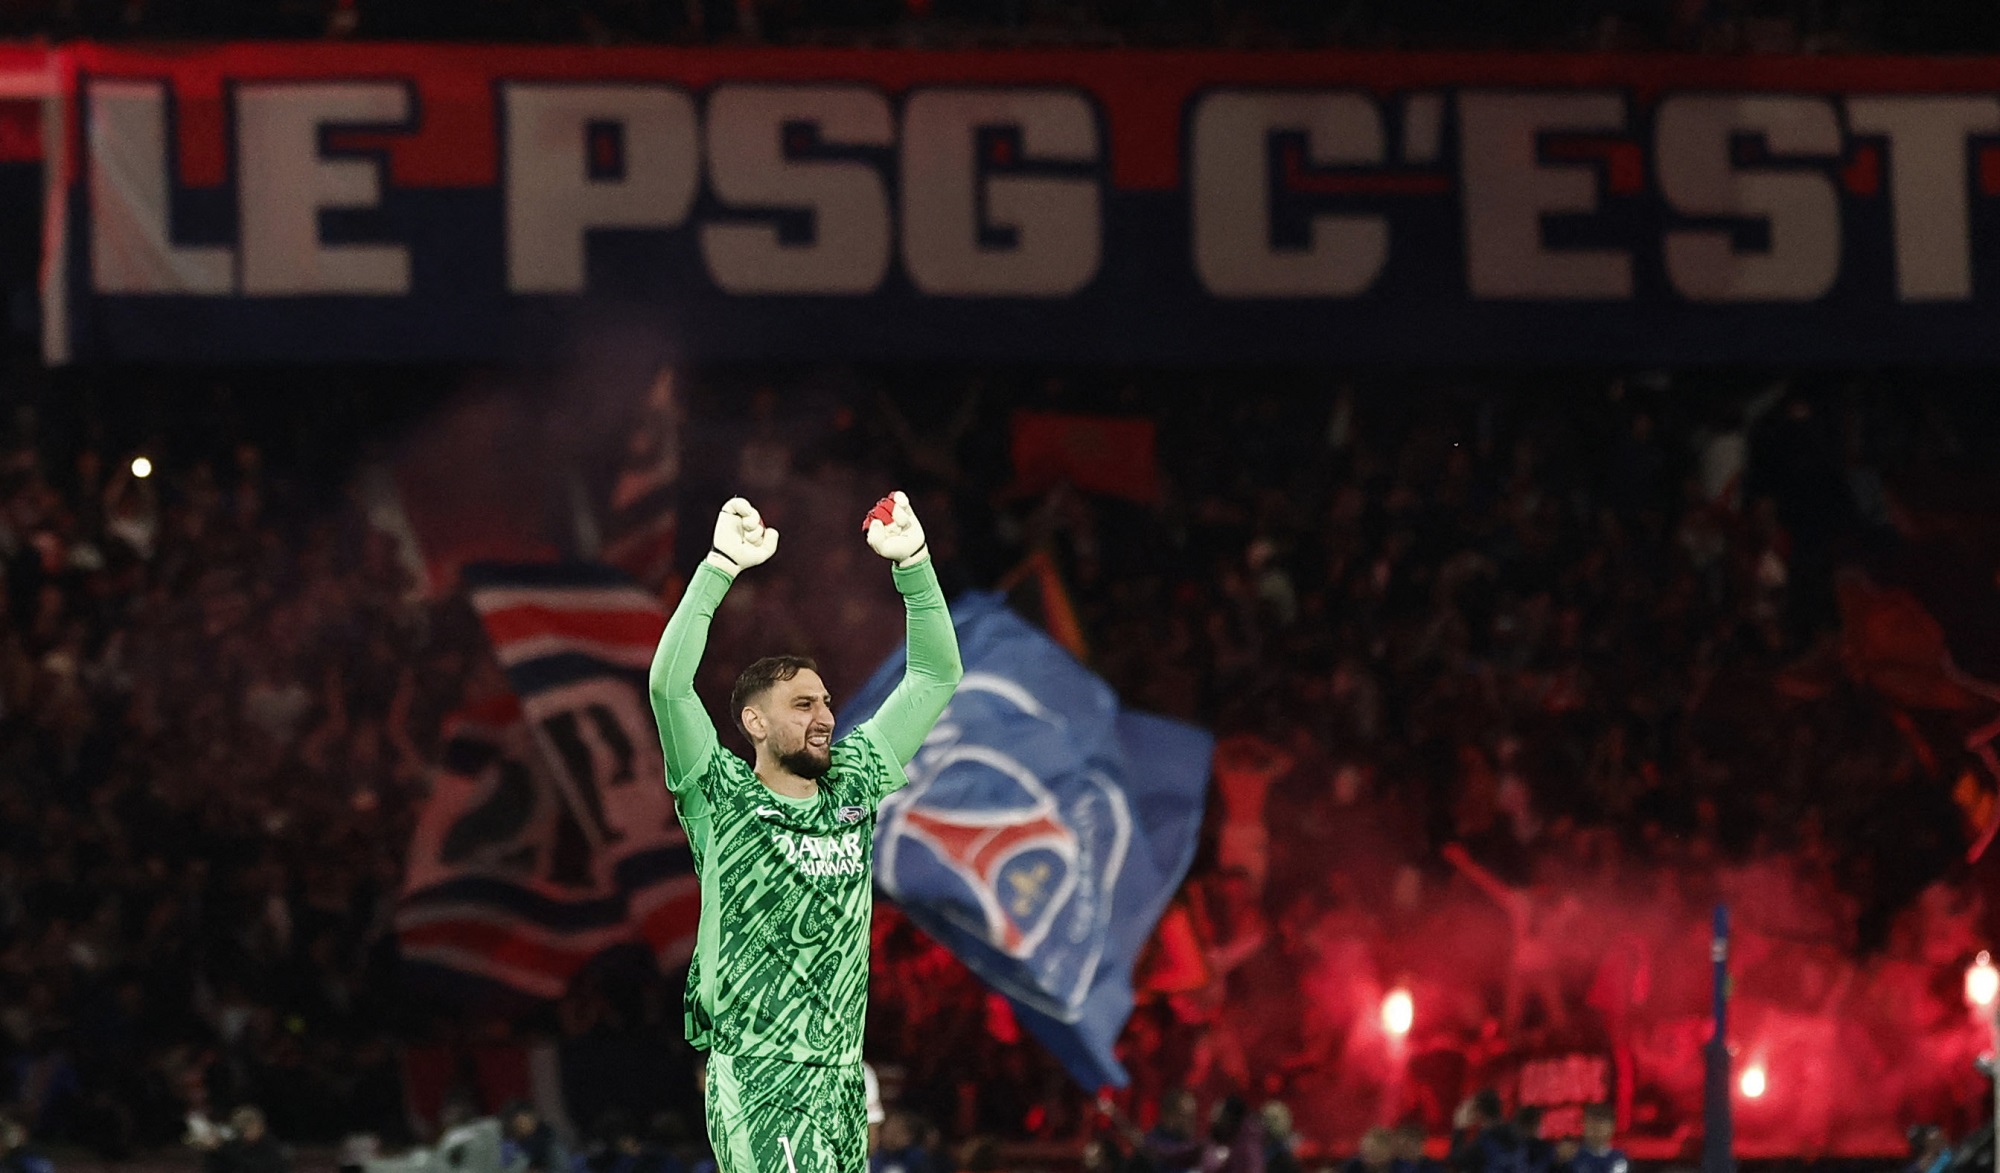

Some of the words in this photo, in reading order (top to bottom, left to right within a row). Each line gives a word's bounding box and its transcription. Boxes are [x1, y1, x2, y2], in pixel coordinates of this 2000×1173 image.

[85, 80, 412, 296] LE
[504, 81, 1103, 299] PSG
[1191, 88, 2000, 302] C'EST
[772, 832, 862, 864] QATAR
[800, 859, 864, 878] AIRWAYS
